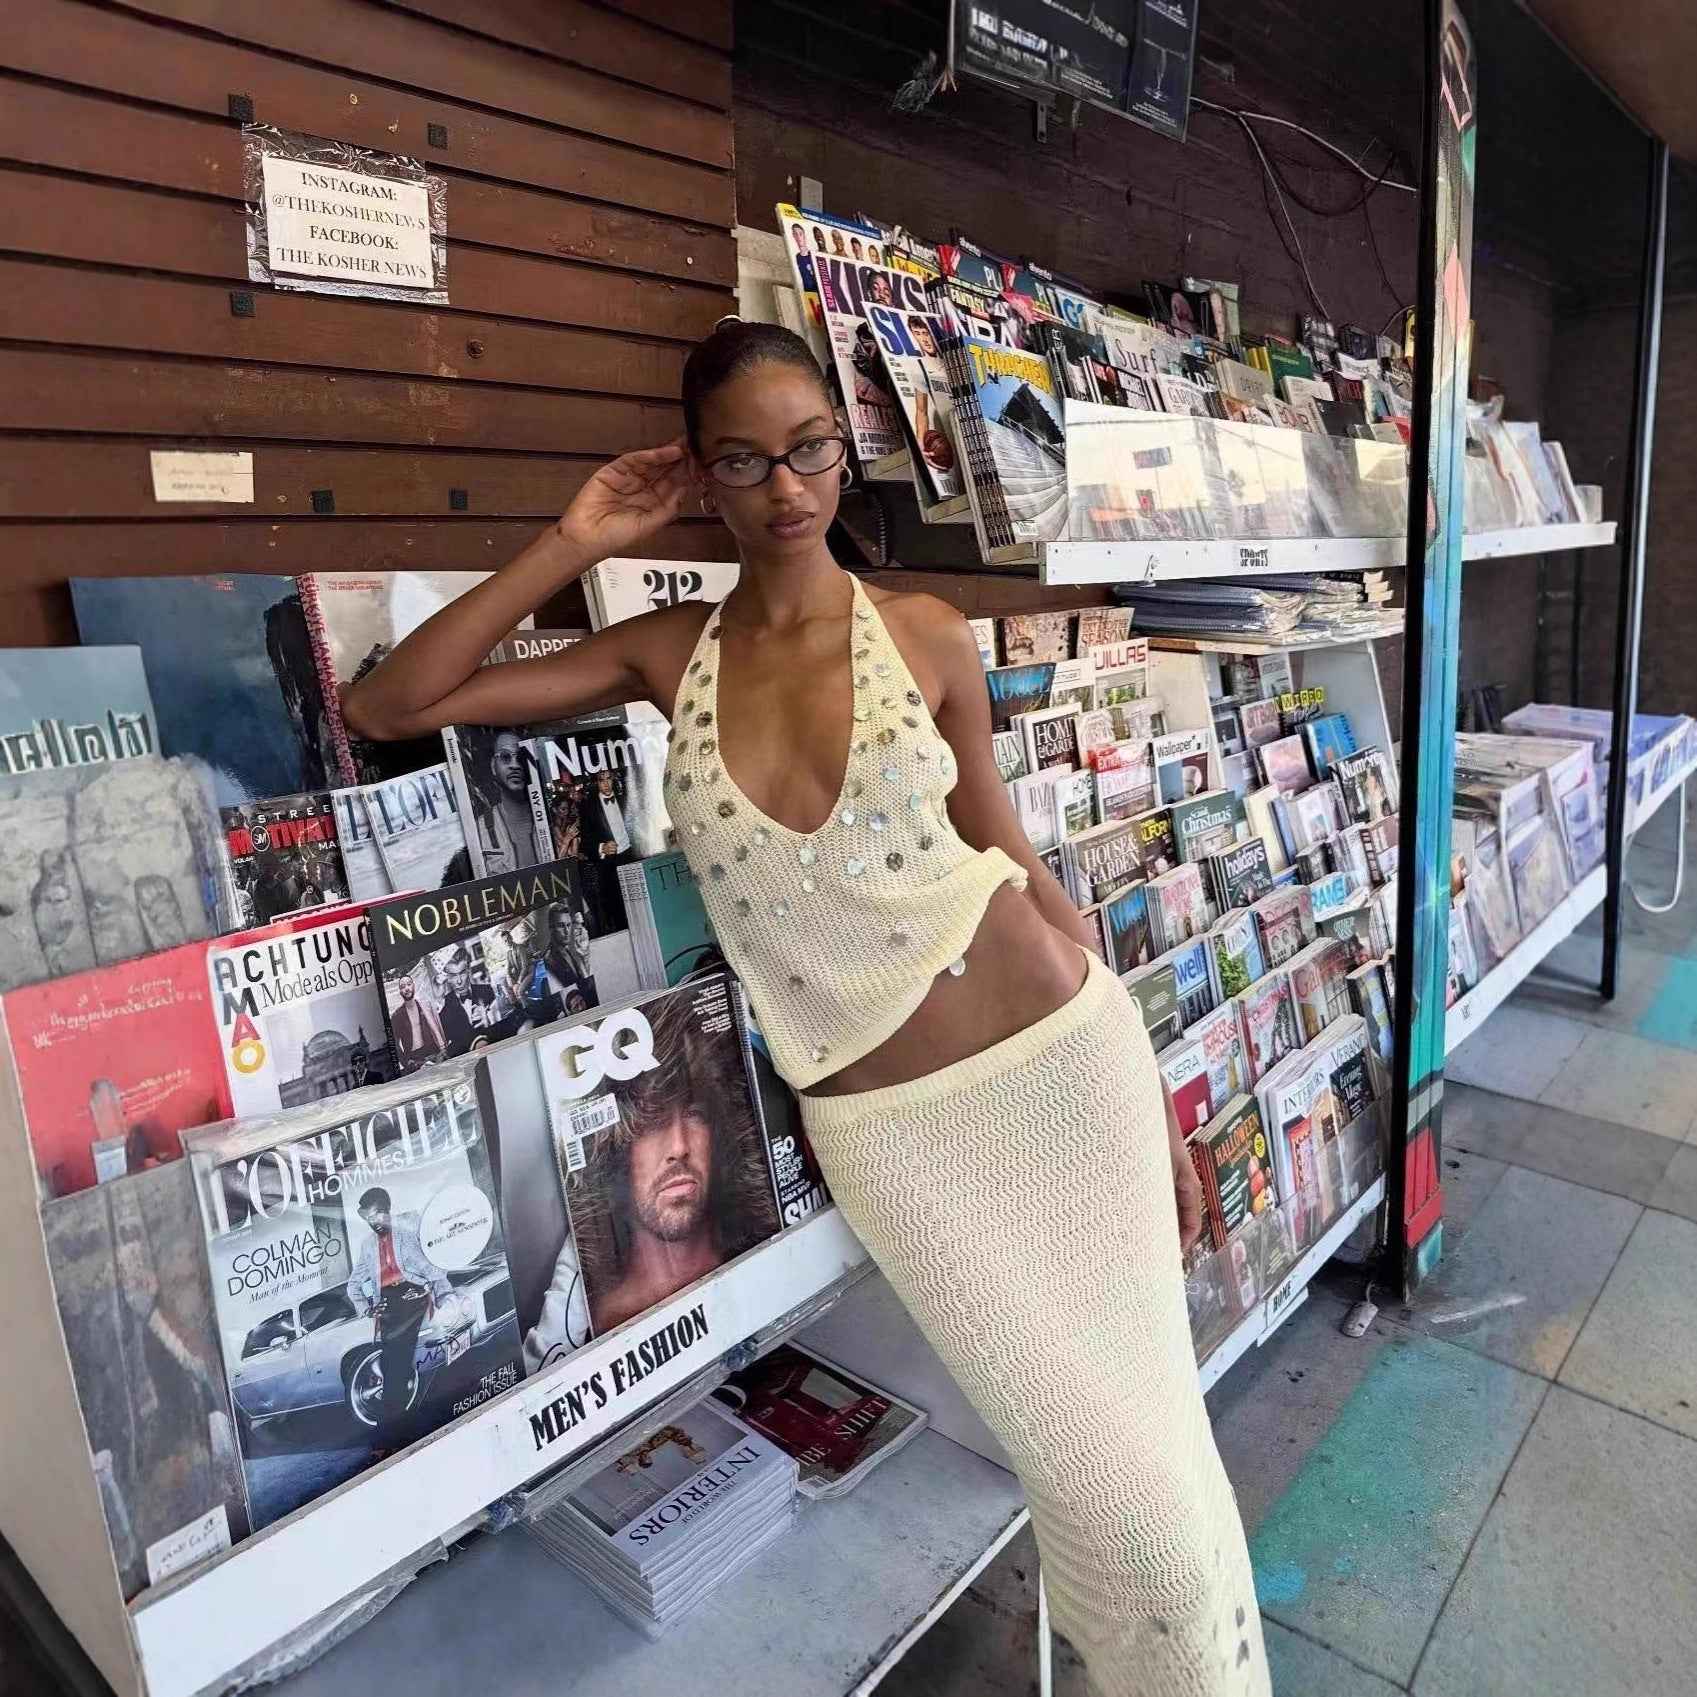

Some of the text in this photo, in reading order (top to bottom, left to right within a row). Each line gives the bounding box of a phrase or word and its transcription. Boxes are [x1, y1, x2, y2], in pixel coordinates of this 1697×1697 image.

[301, 172, 398, 201] INSTAGRAM:
[309, 224, 399, 250] FACEBOOK:
[276, 247, 427, 279] THE KOSHER NEWS
[643, 569, 704, 609] 212
[385, 868, 572, 945] NOBLEMAN
[260, 976, 313, 1010] Mode
[313, 965, 338, 994] als
[535, 1008, 662, 1099] GQ
[211, 1092, 482, 1233] L'OFFICIEL
[772, 1135, 795, 1160] 50
[309, 1149, 406, 1204] HOMMES
[227, 1238, 343, 1297] DOMINGO
[232, 1223, 333, 1275] COLMAN
[453, 1374, 518, 1415] FASHION ISSUE
[480, 1362, 517, 1389] THE FALL
[529, 1304, 709, 1451] MEN'S FASHION
[628, 1444, 761, 1546] INTERIORS
